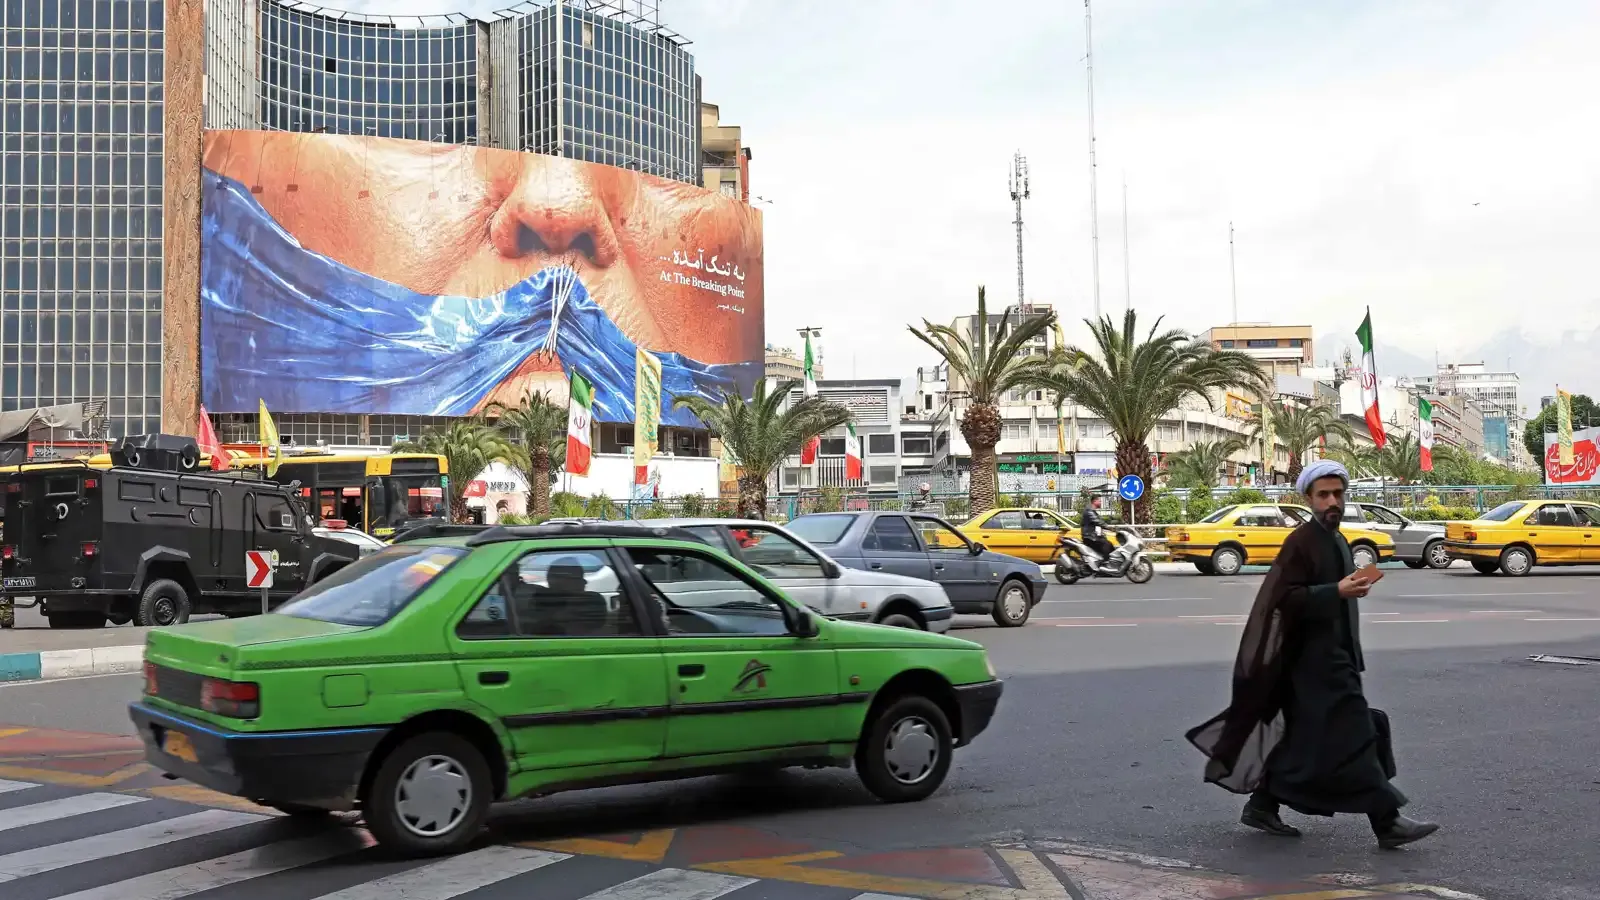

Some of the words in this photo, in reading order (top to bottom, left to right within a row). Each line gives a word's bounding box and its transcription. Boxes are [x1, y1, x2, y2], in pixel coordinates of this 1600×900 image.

[705, 255, 731, 277] تنگ
[733, 264, 745, 286] به
[660, 270, 672, 282] At
[673, 272, 691, 286] The
[692, 276, 727, 297] Breaking
[727, 284, 745, 299] Point
